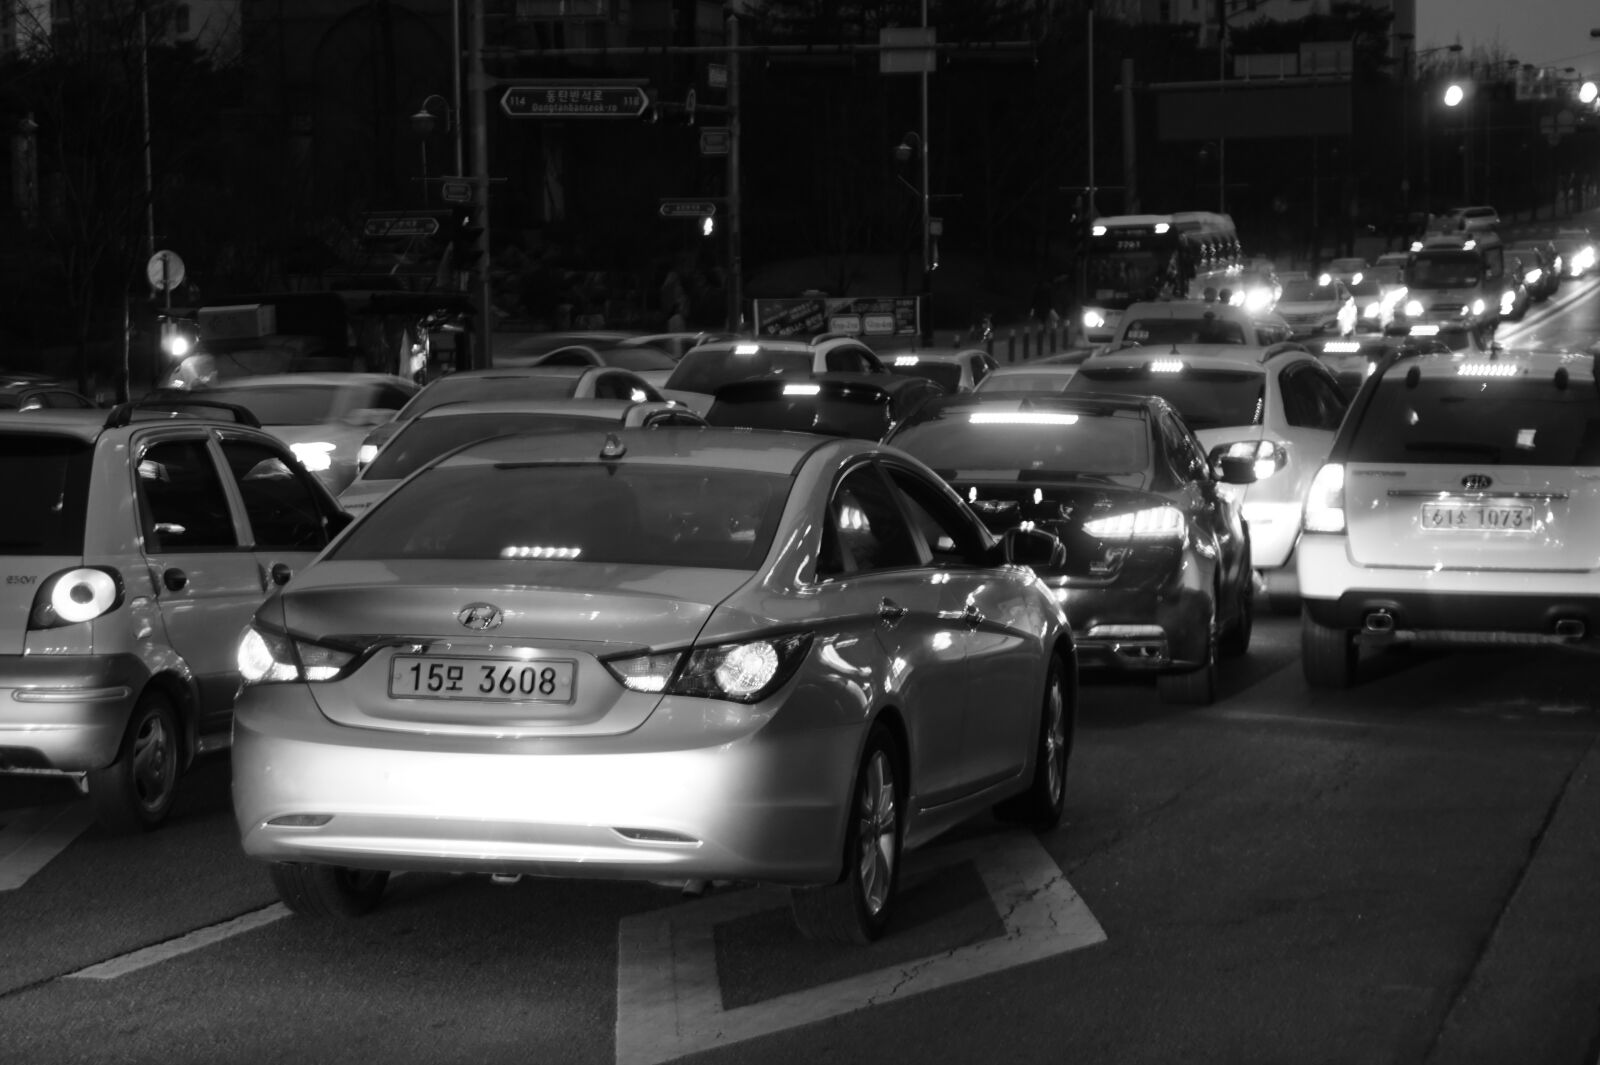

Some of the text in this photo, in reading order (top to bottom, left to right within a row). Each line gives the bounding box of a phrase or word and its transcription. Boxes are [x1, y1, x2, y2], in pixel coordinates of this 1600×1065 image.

[510, 96, 527, 106] 114
[546, 89, 604, 103] 동탄반석로
[1432, 508, 1524, 527] 61소 1073
[410, 662, 556, 696] 15모 3608
